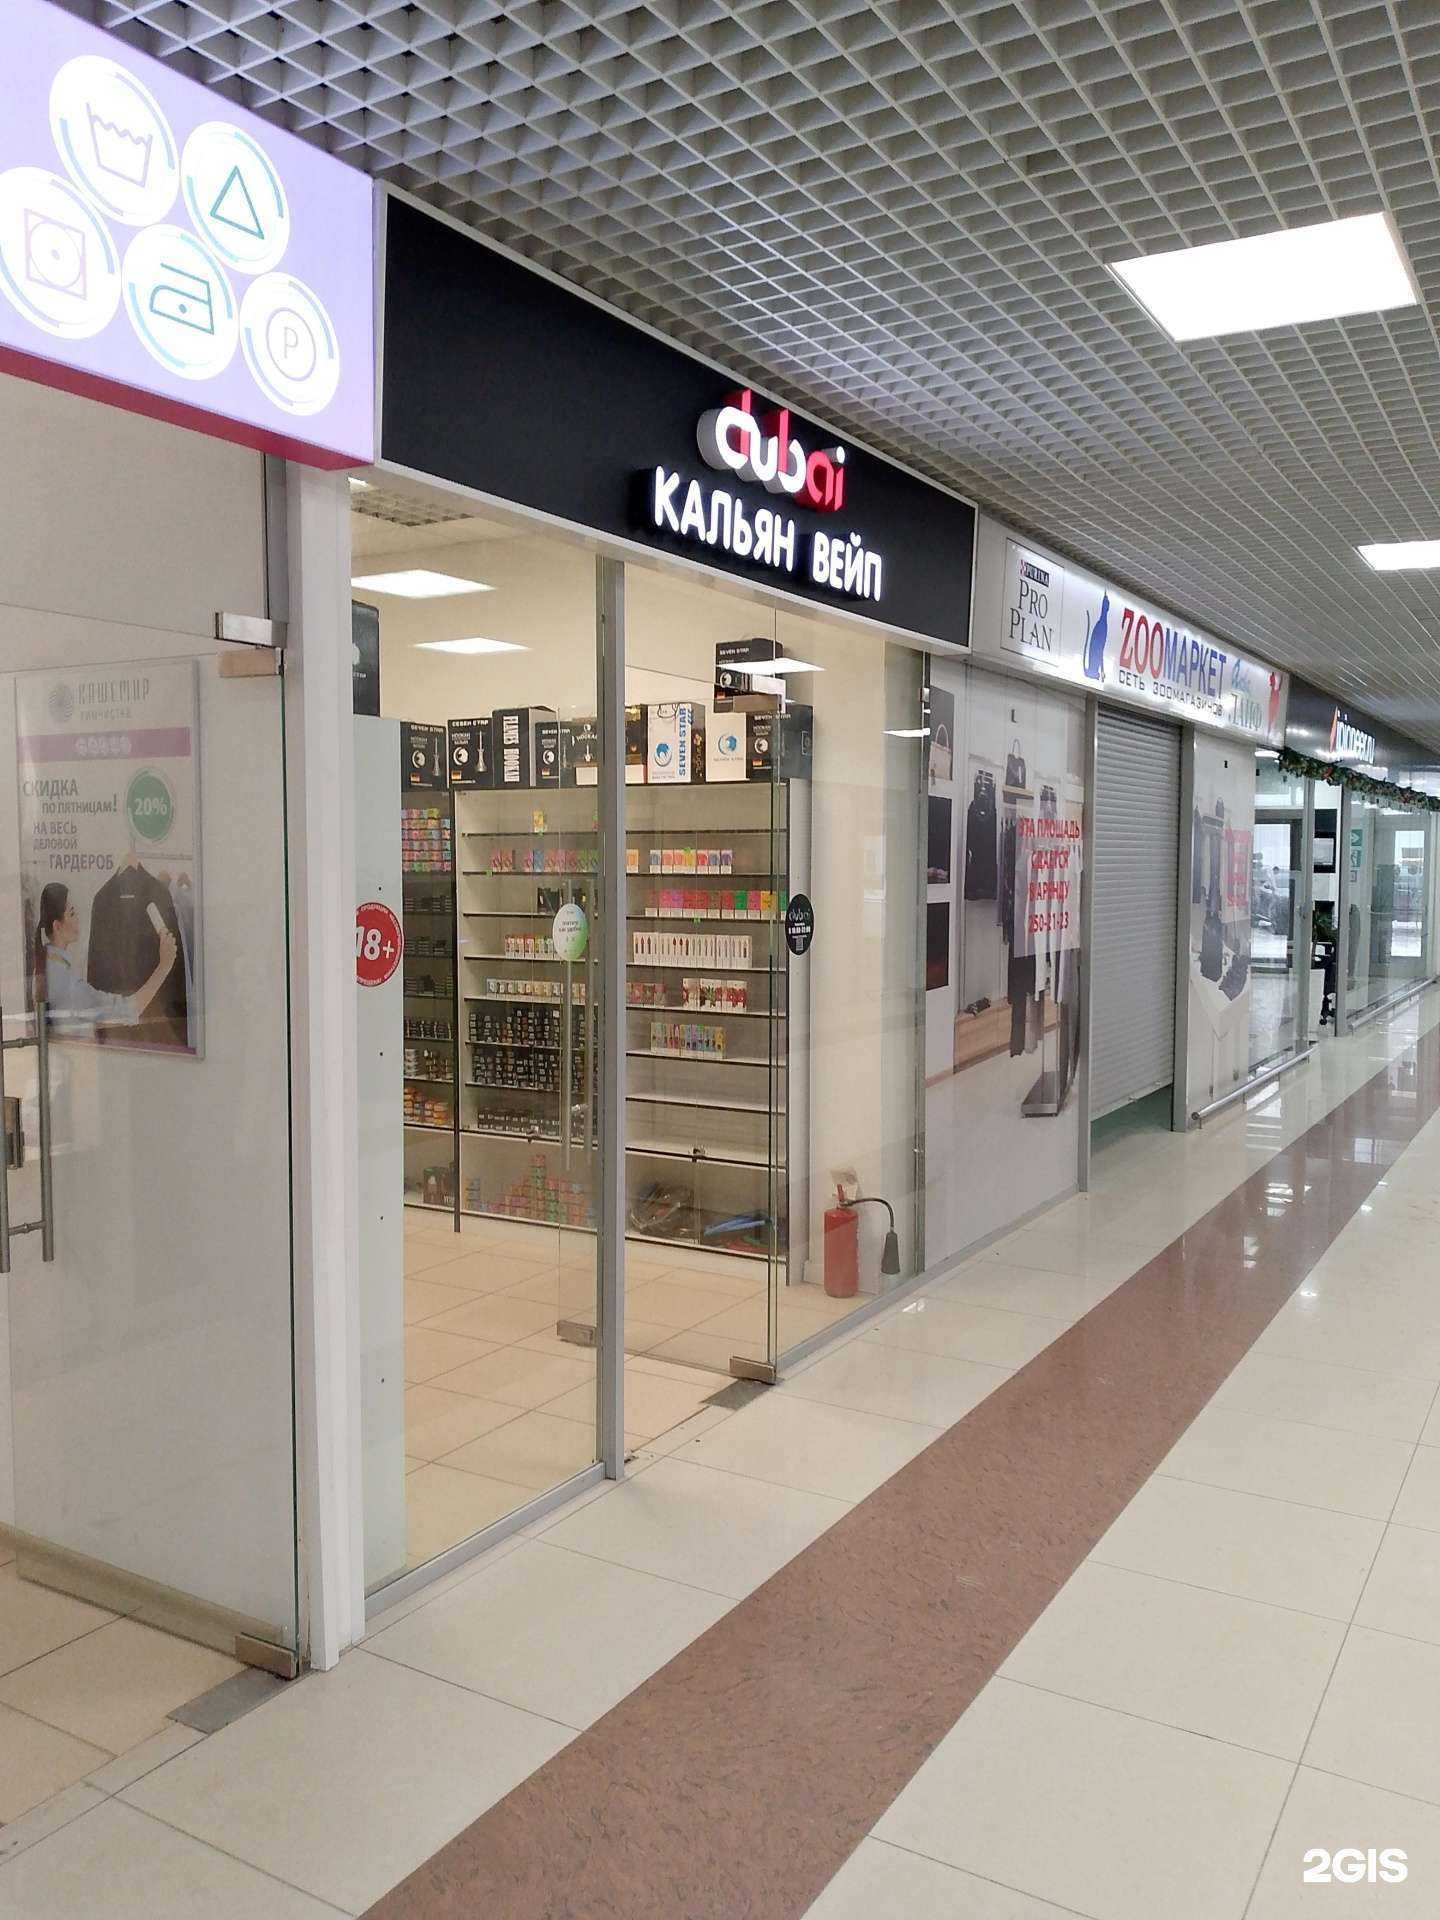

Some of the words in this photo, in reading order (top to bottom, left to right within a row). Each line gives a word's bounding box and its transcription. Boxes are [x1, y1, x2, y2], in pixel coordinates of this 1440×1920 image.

[702, 387, 846, 512] dubai
[654, 465, 795, 572] КАЛЬЯН
[812, 532, 882, 601] ВЕЙП
[1019, 578, 1048, 619] PRO
[1009, 607, 1052, 652] PLAN
[1118, 669, 1145, 691] СЕТЬ
[1153, 681, 1223, 717] ЗООМАГАЗИНОВ
[23, 779, 79, 800] СКИДКА
[42, 801, 55, 814] ПО
[58, 794, 118, 815] ПЯТНИЦАМ!
[134, 797, 168, 816] 20%
[33, 822, 48, 834] НА
[50, 821, 77, 834] ВЕСЬ
[1018, 818, 1035, 837] ЭТА
[1037, 819, 1080, 840] ПЛОЩАДЬ
[33, 838, 78, 851] ДЕЛОВОЙ
[49, 854, 114, 872] ГАРДЕРОБ
[355, 926, 394, 960] 18+
